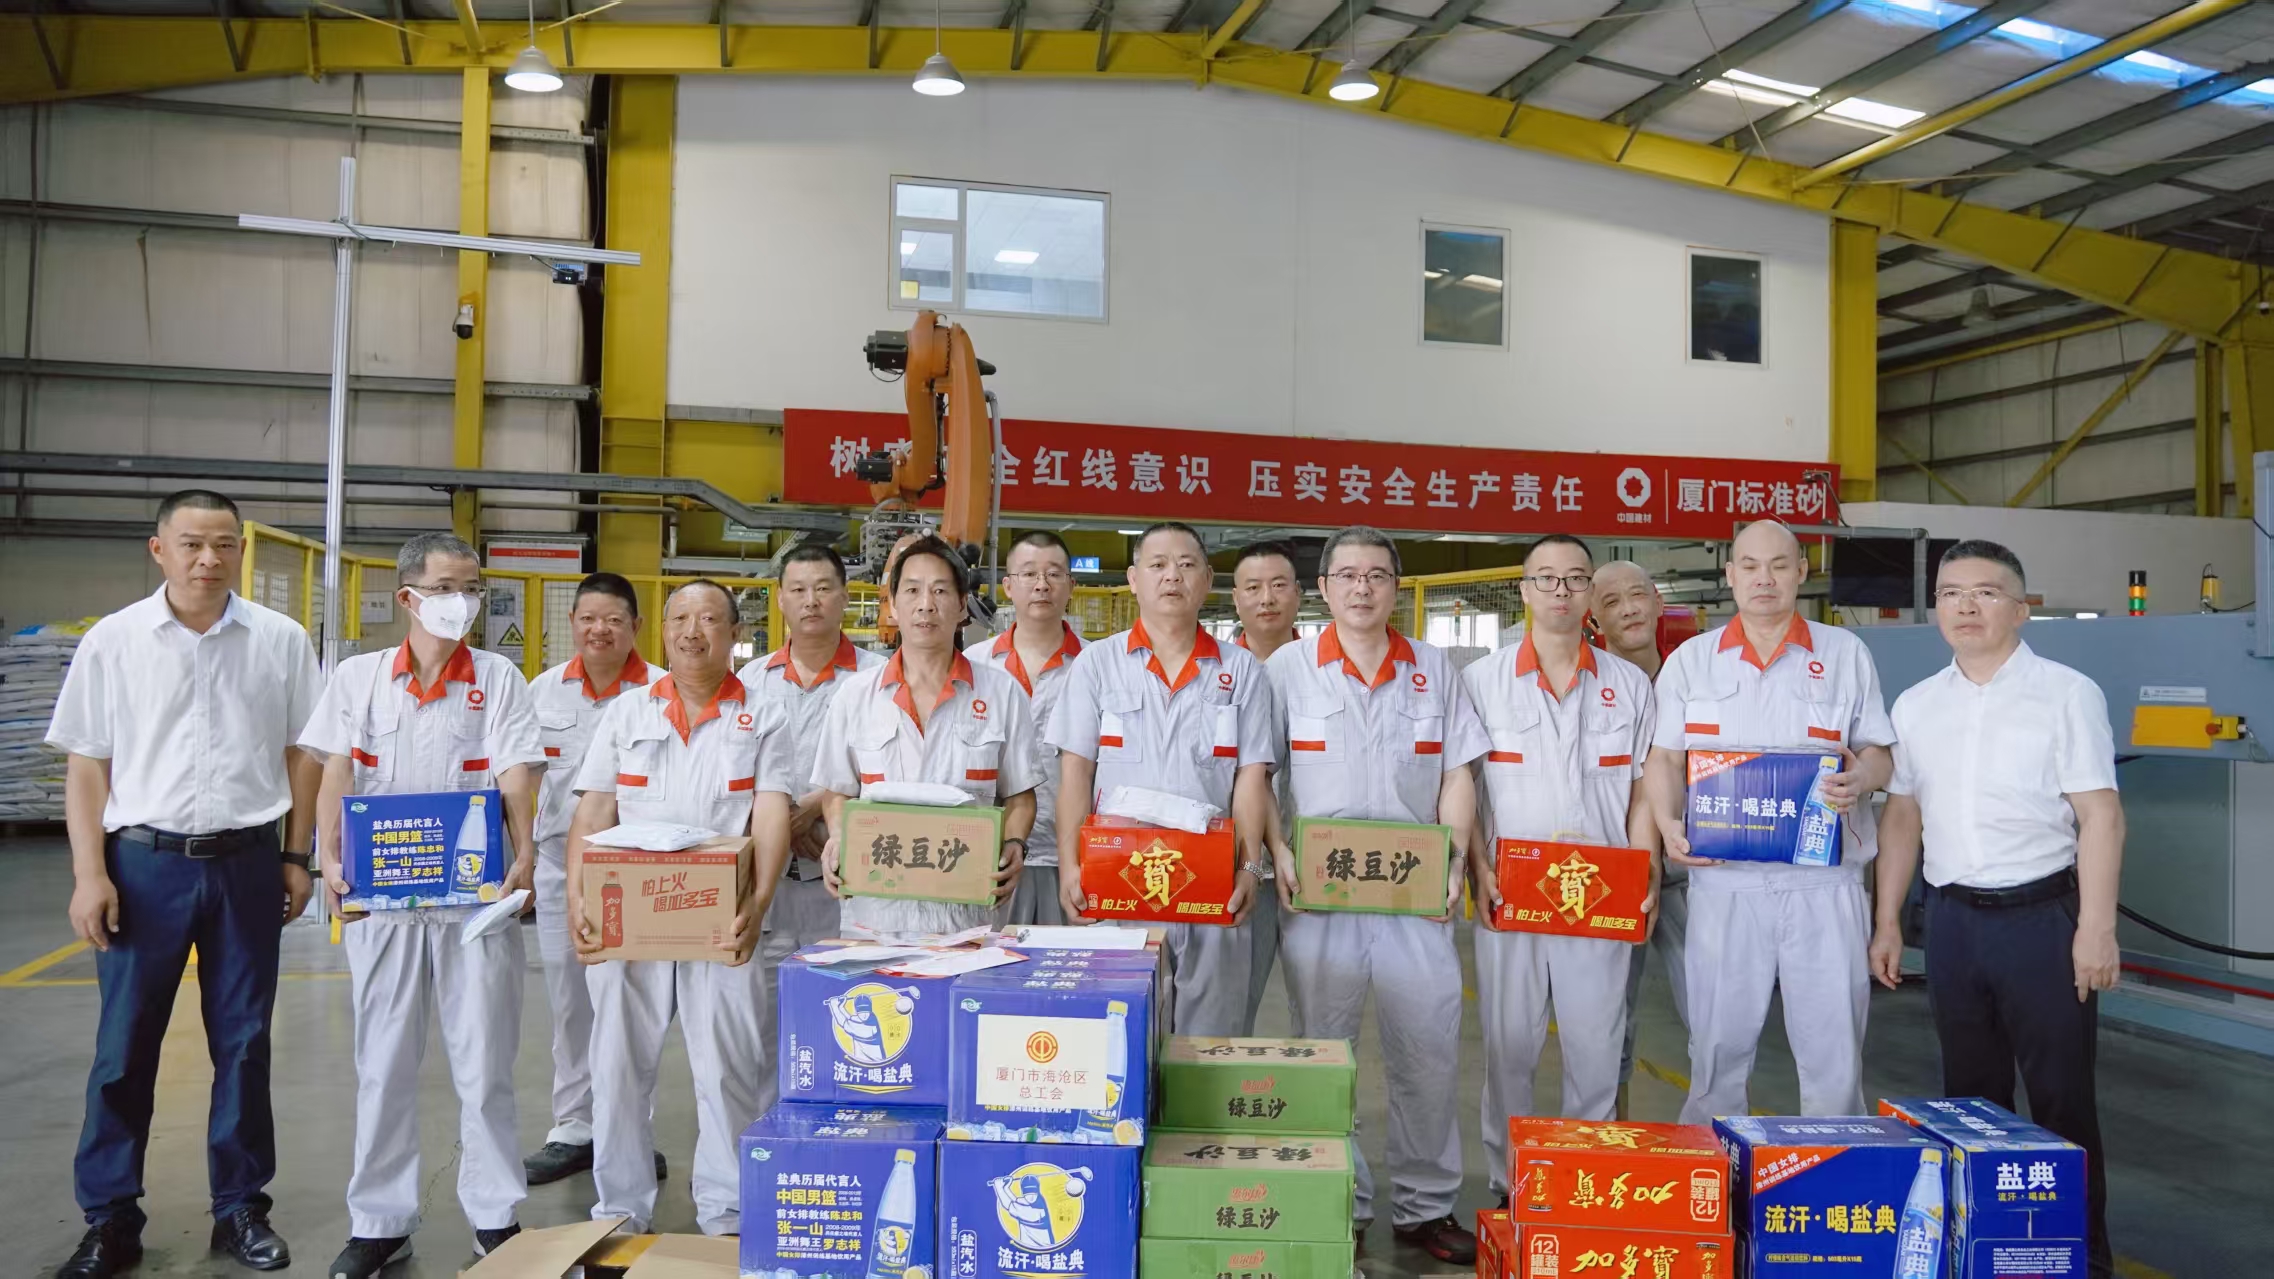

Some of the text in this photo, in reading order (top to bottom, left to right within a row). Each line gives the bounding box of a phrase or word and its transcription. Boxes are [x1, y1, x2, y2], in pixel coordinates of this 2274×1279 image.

[830, 436, 1583, 513] 树全红线意识 压实安全生产责任
[1677, 478, 1825, 517] 厦门标准砂
[1617, 513, 1652, 523] 中国建材
[1695, 794, 1797, 818] 流汗·喝盐典
[372, 817, 443, 830] 盐典历届代言人
[1804, 814, 1828, 854] 盐典
[372, 830, 423, 845] 中国男篮
[372, 856, 412, 869] 张一山
[871, 833, 971, 873] 绿豆沙
[1326, 848, 1421, 884] 绿豆沙
[642, 871, 687, 897] 怕上火
[653, 888, 719, 912] 喝加多宝
[1101, 898, 1138, 911] 怕上火
[1176, 901, 1224, 915] 喝加多宝
[1516, 908, 1553, 923] 怕上火
[1589, 915, 1638, 930] 喝加多宝
[799, 1049, 813, 1087] 盐汽水
[833, 1060, 913, 1084] 流汗·喝盐典
[996, 1066, 1090, 1084] 厦门市海沧区
[1019, 1086, 1063, 1100] 总工会
[1228, 1097, 1287, 1119] 绿豆沙
[1758, 1152, 1799, 1177] 中国女排
[1996, 1161, 2057, 1190] 盐典
[776, 1172, 861, 1187] 盐典历届代言人
[776, 1188, 837, 1206] 中国男篮
[1998, 1192, 2057, 1201] 流汗·喝盐典
[776, 1208, 863, 1221] 前女排教练陈忠和
[1216, 1206, 1280, 1230] 绿豆沙
[1695, 1201, 1716, 1215] 12
[777, 1220, 823, 1236] 张一山
[1765, 1205, 1897, 1234] 流汗·喝盐典
[960, 1233, 975, 1274] 盐汽水
[1534, 1240, 1554, 1254] 12
[1905, 1227, 1934, 1279] 盐典
[997, 1246, 1084, 1271] 流汗·喝盐典
